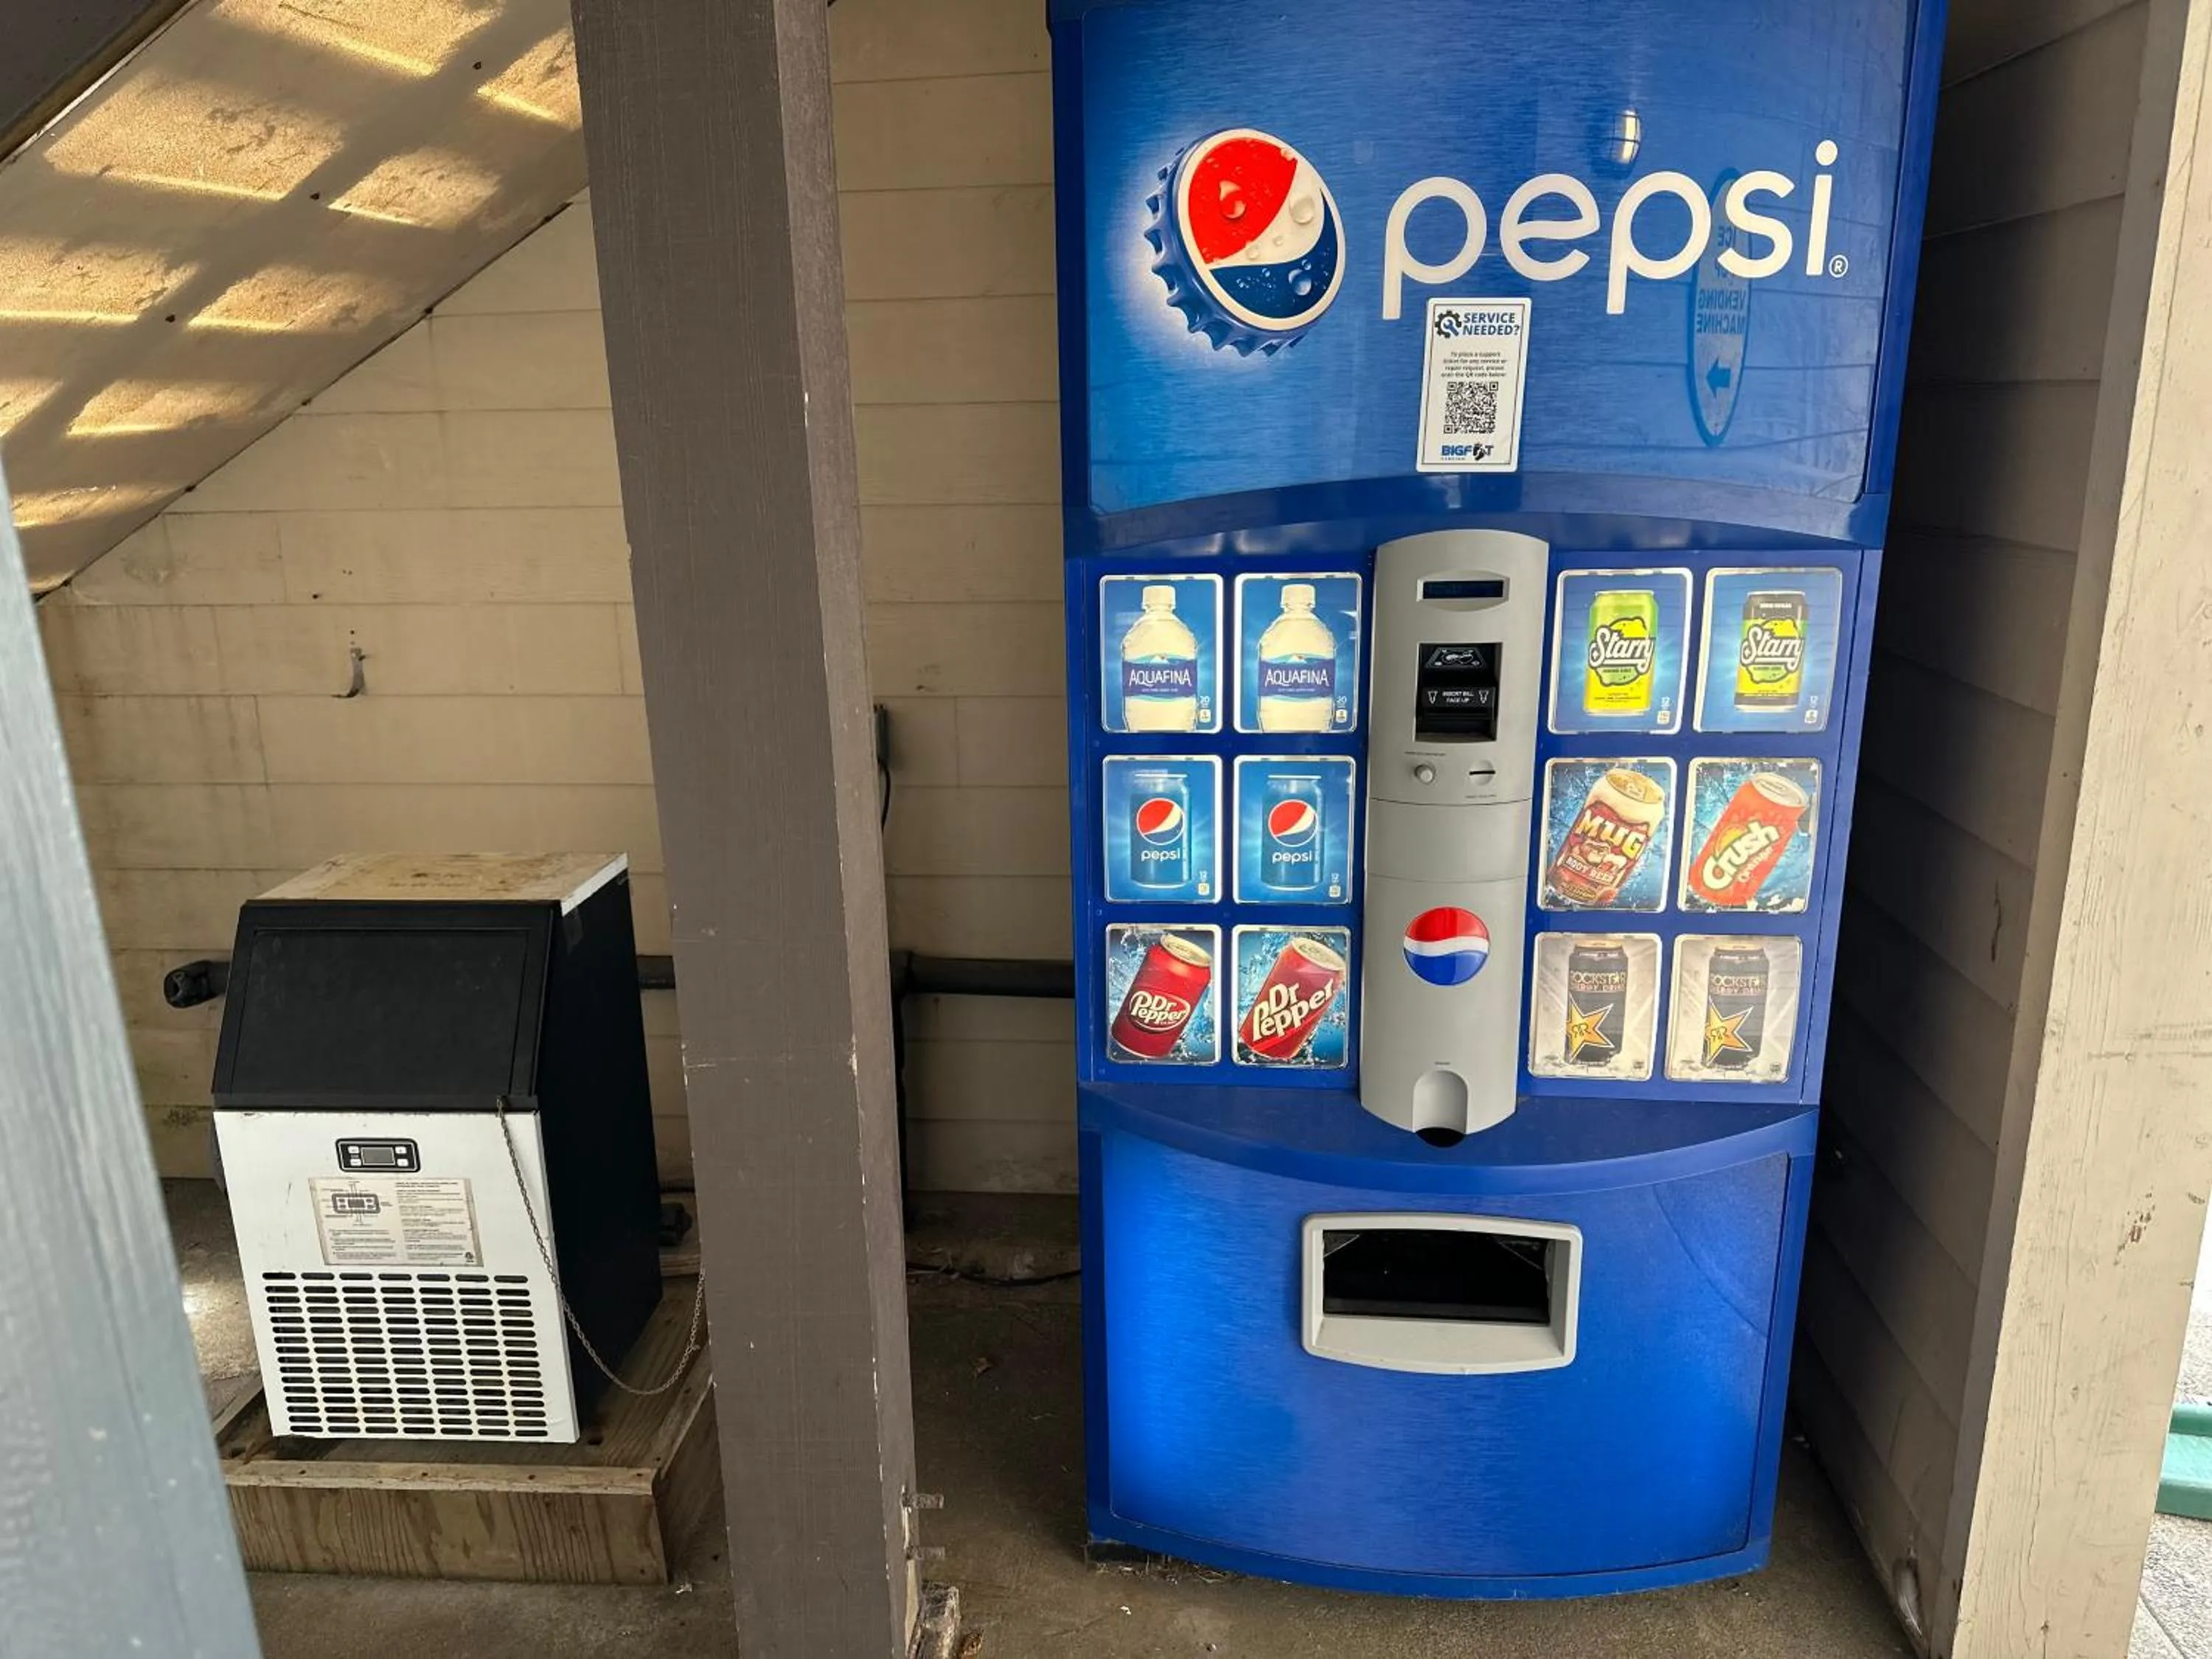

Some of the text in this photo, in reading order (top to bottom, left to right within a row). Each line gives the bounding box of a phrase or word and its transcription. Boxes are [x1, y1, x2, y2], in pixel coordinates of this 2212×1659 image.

[1382, 140, 1837, 320] pepsi
[1463, 312, 1515, 324] SERVICE
[1462, 324, 1520, 335] NEEDED?
[1441, 442, 1495, 460] BIGFT
[1129, 669, 1192, 687] AQUAFINA
[1265, 668, 1330, 687] AQUAFINA
[1574, 809, 1646, 859] MUG
[1141, 847, 1181, 863] pepsi
[1272, 849, 1312, 864] pepsi
[1703, 821, 1781, 889] Crush
[1151, 995, 1178, 1012] Dr
[1269, 982, 1300, 1008] Dr
[1130, 991, 1186, 1025] Pepper
[1253, 979, 1335, 1042] Pepper
